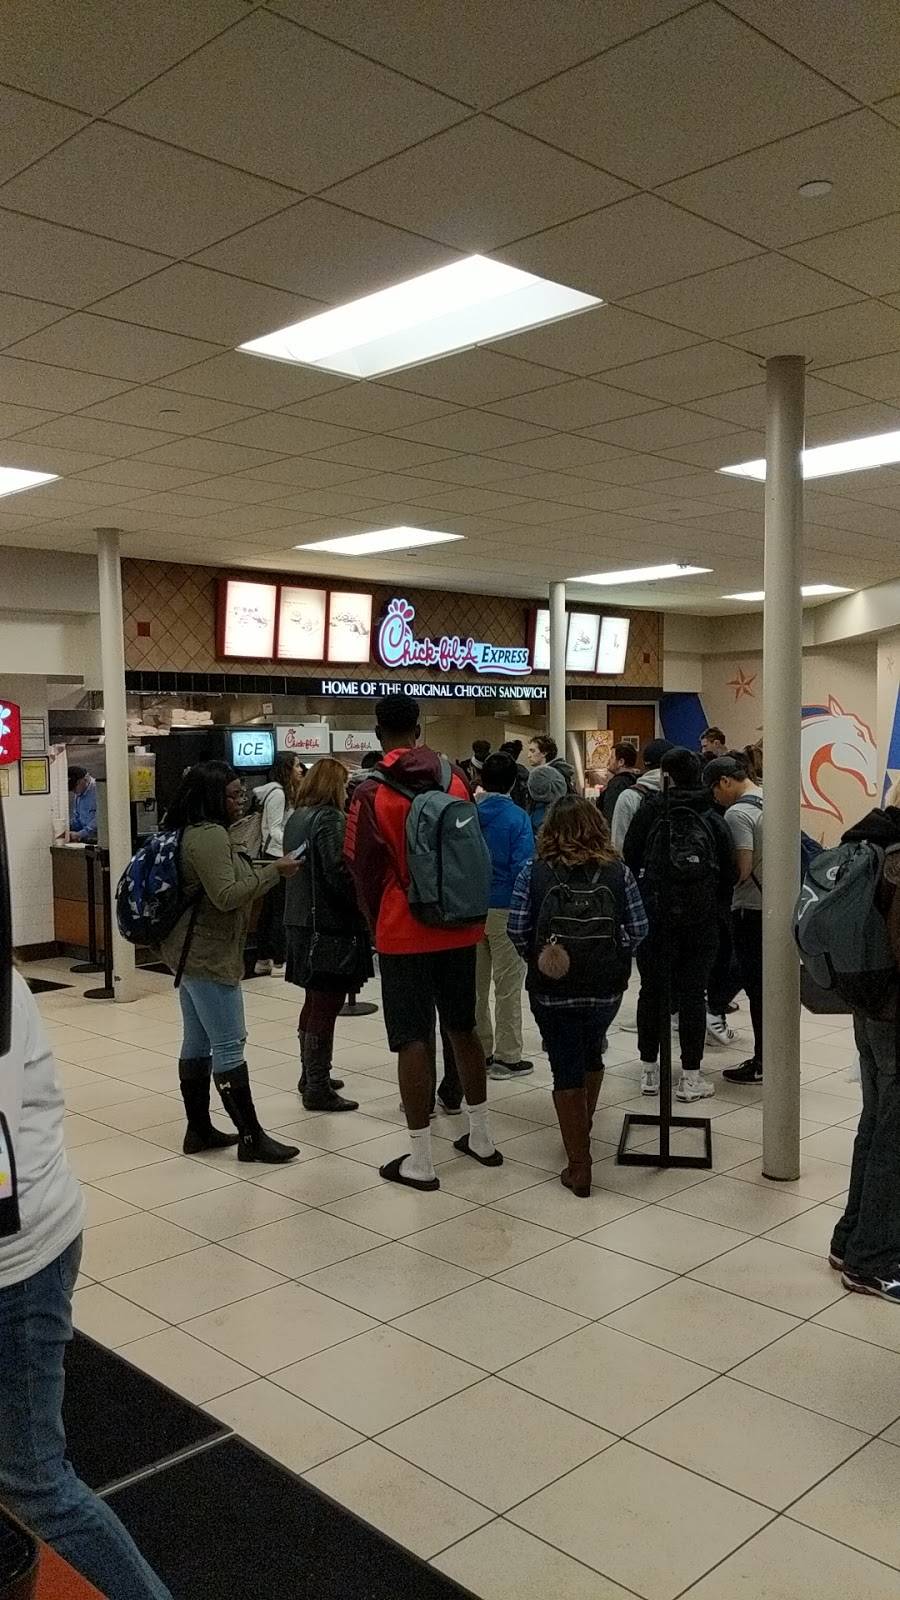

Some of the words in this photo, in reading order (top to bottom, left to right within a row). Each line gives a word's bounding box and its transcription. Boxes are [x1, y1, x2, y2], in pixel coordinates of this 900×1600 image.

[379, 598, 479, 670] Chick-fil-A
[481, 645, 528, 664] EXPRESS
[321, 680, 358, 695] HOME
[360, 681, 377, 695] OF
[404, 683, 453, 697] ORIGINAL
[454, 684, 497, 698] CHICKEN
[499, 685, 547, 699] SANDWICH
[238, 742, 264, 756] ICE
